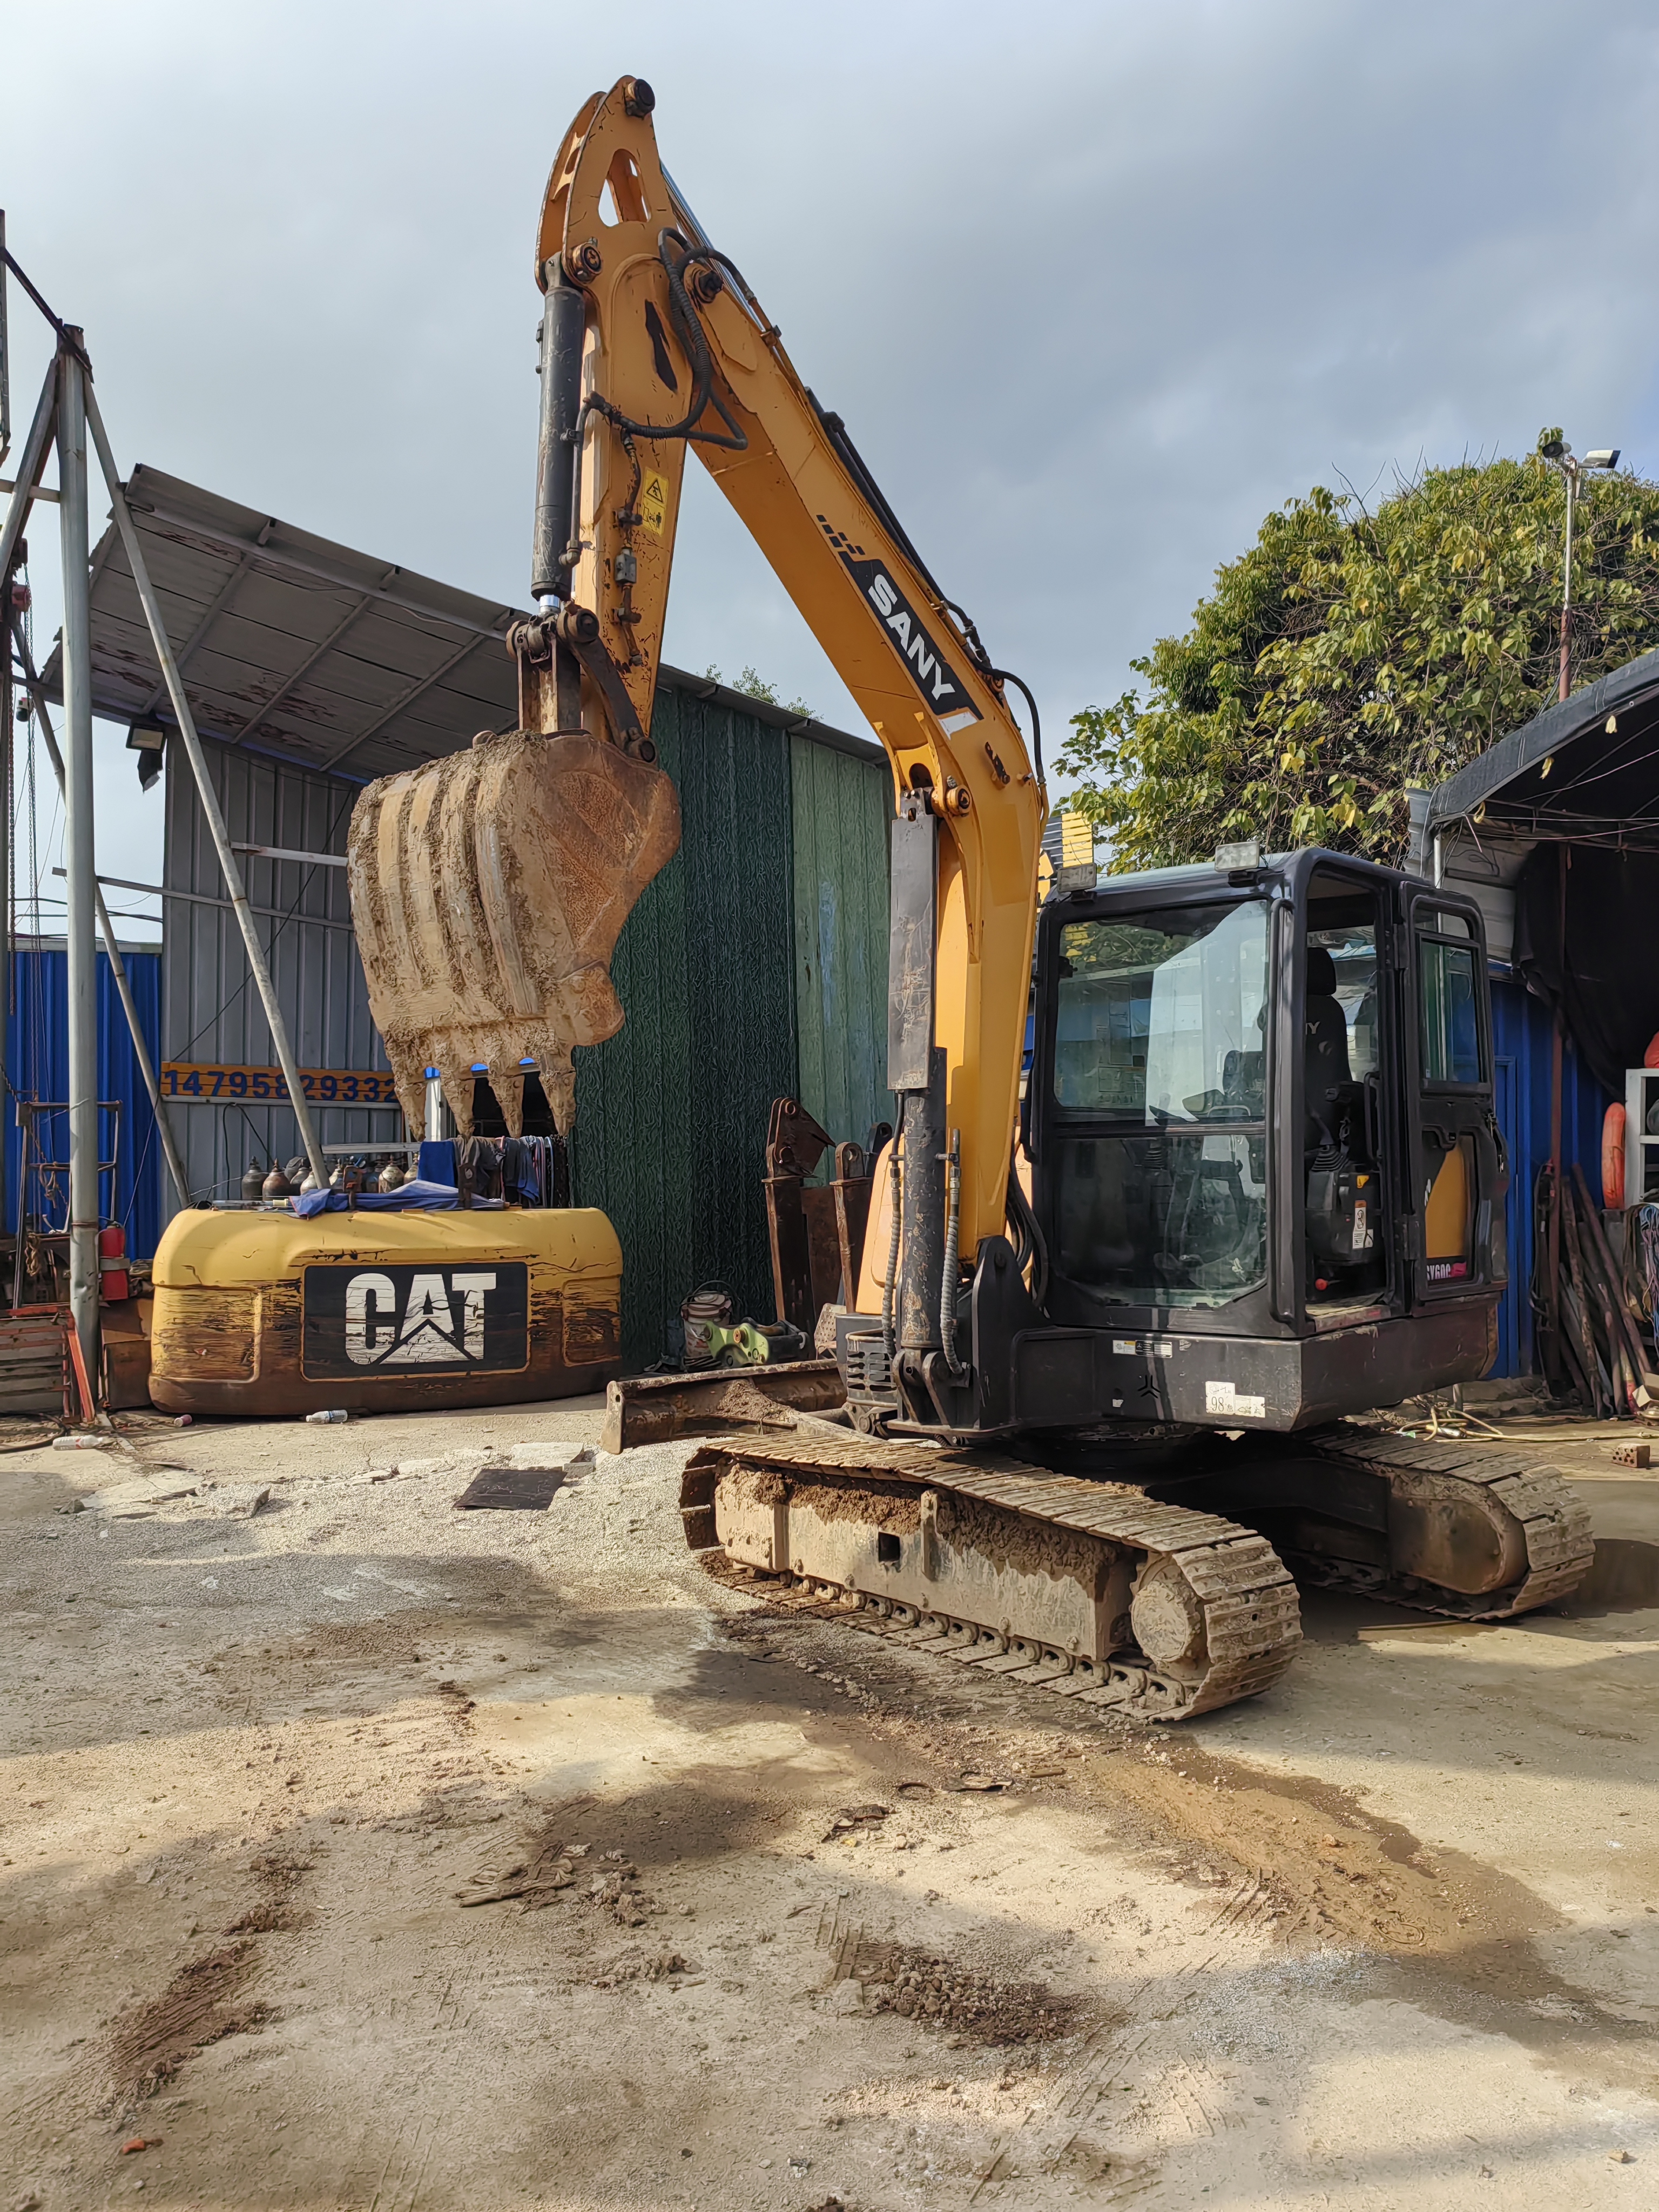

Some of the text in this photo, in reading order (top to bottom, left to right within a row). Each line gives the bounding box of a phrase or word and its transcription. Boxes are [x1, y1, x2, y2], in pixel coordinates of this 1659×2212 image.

[868, 574, 955, 700] SANY
[164, 1069, 400, 1102] 14795829332
[346, 1273, 496, 1365] CAT
